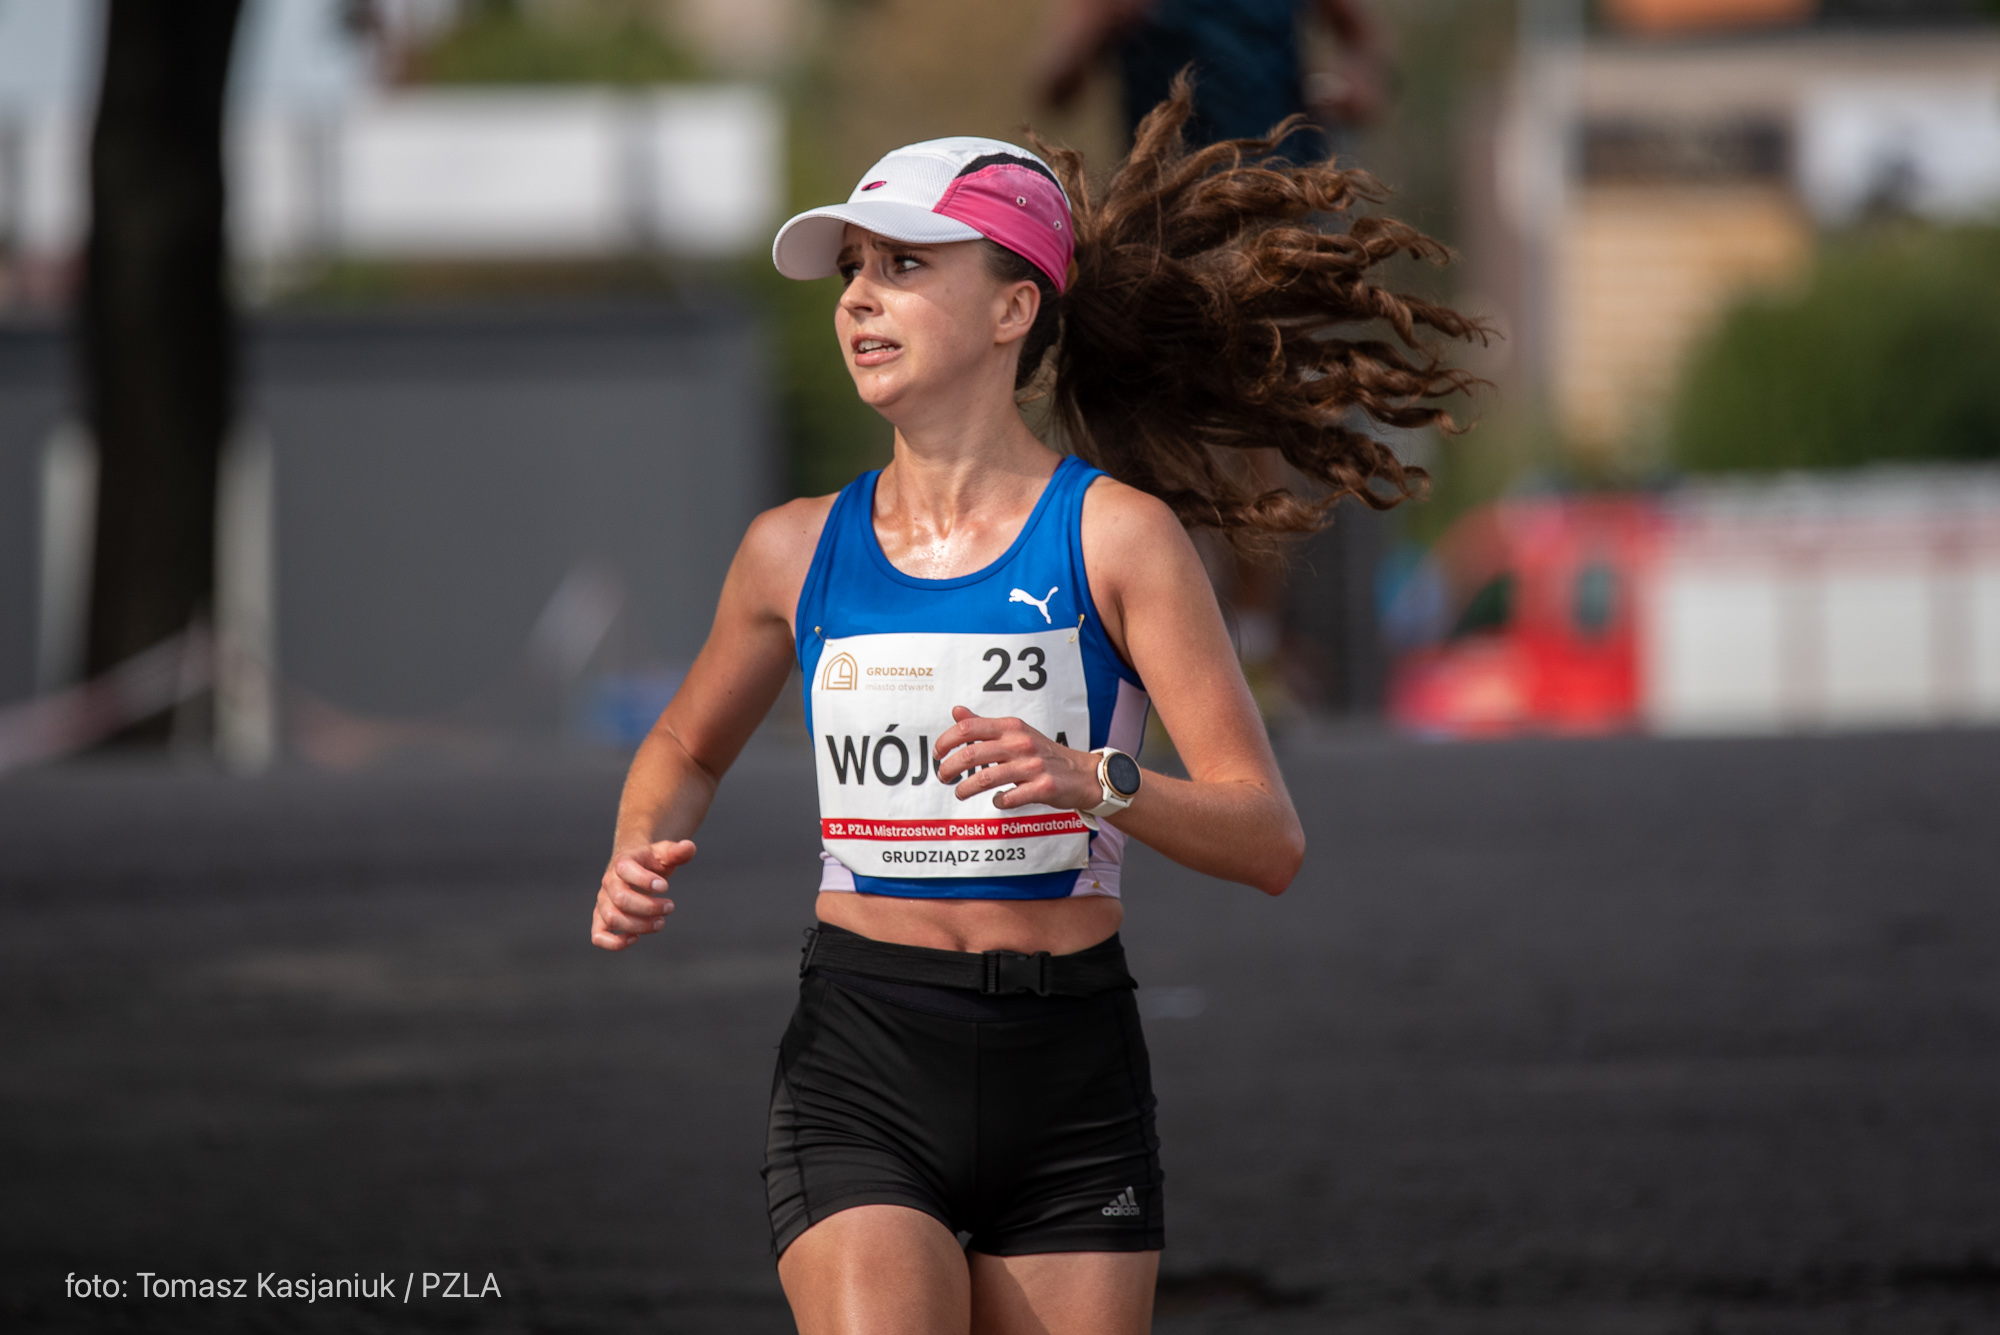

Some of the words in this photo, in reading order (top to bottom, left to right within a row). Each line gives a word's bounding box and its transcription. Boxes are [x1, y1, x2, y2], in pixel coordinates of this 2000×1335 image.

[866, 667, 933, 679] GRUDZIĄDZ
[981, 646, 1048, 692] 23
[865, 682, 896, 691] miasto
[897, 683, 935, 691] otwarte
[828, 823, 847, 836] 32.
[848, 824, 873, 837] PZLA
[873, 824, 946, 838] Mistrzostwa
[949, 823, 985, 837] Polski
[987, 825, 999, 836] w
[1001, 816, 1084, 835] Półmaratonie
[882, 850, 980, 866] GRUDZIĄDZ
[984, 847, 1026, 861] 2023
